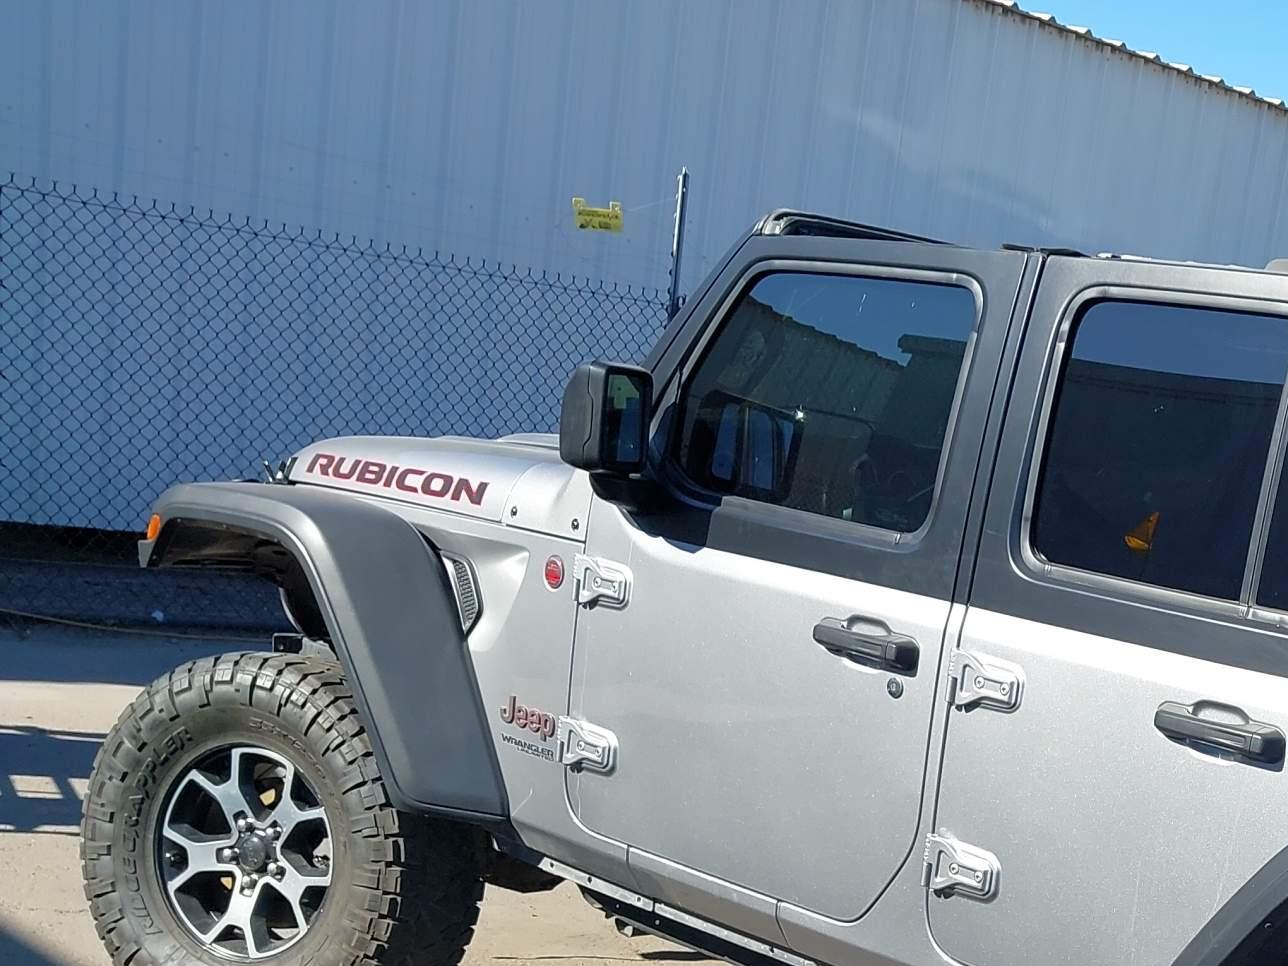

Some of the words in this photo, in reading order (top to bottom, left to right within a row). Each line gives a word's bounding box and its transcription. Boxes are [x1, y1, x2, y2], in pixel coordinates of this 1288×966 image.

[305, 453, 490, 506] RUBICON
[499, 695, 556, 742] Jeep
[501, 733, 555, 758] WRANGLER
[123, 725, 193, 854] GRAPPLER
